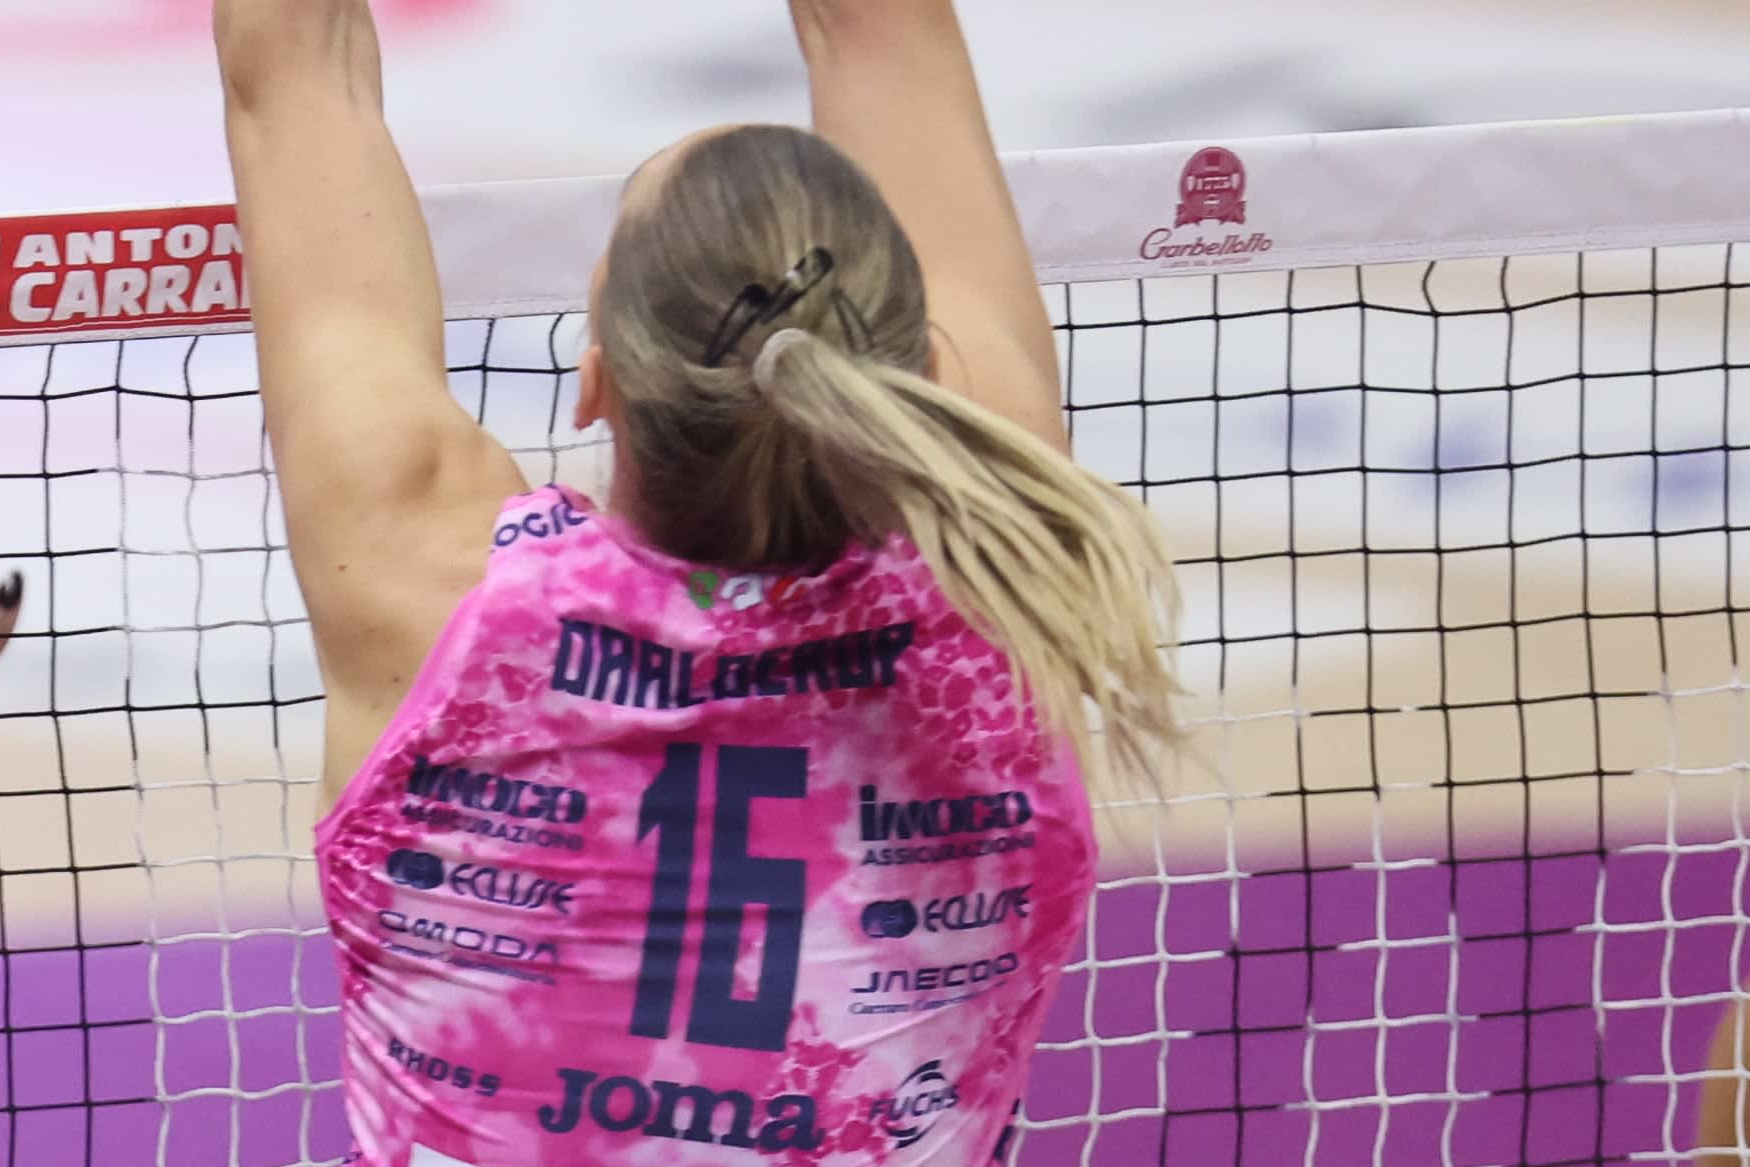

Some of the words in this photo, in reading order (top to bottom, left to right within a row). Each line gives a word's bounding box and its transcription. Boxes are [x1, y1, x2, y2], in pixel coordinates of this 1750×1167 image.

[1139, 228, 1275, 261] Garbellotto
[629, 742, 810, 1053] 16
[388, 1037, 502, 1098] RHOSS
